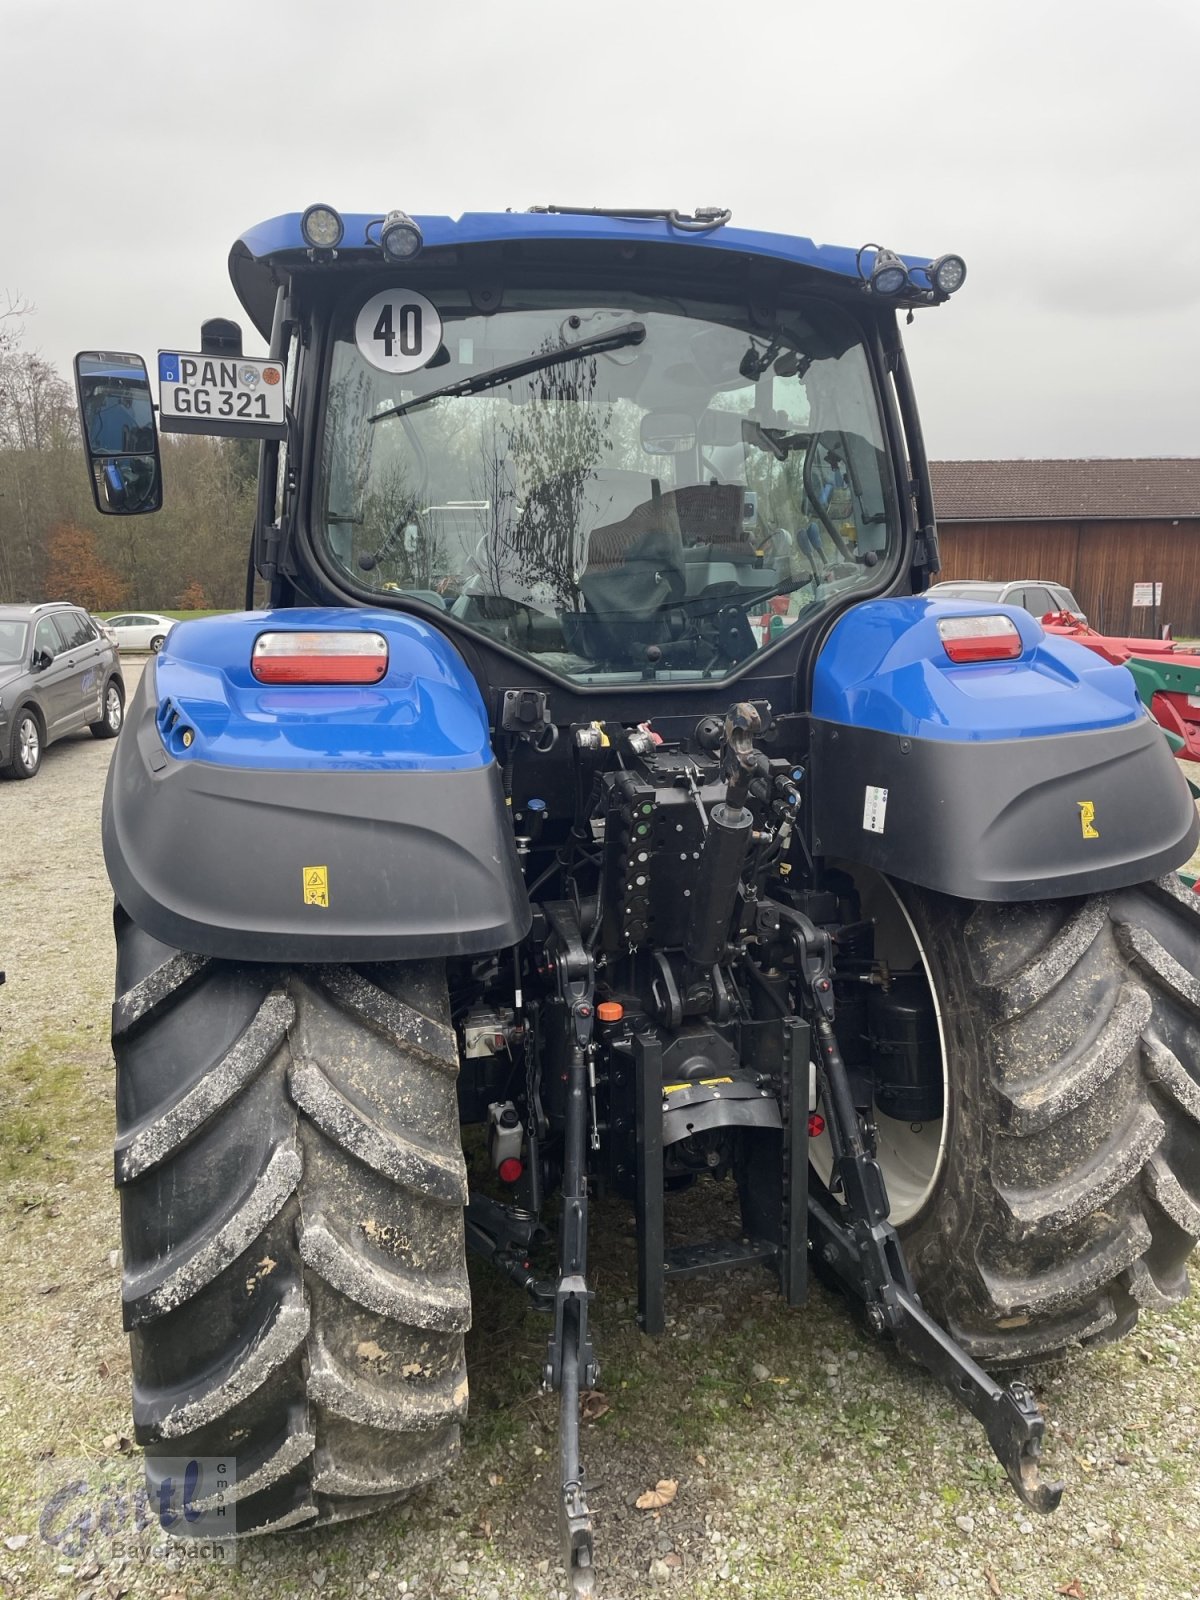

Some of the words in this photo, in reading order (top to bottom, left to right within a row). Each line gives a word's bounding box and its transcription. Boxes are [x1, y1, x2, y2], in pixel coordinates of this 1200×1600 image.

[373, 304, 422, 357] 40
[167, 372, 174, 380] D
[181, 359, 238, 388] PAN
[174, 388, 212, 414] GG
[218, 391, 271, 418] 321
